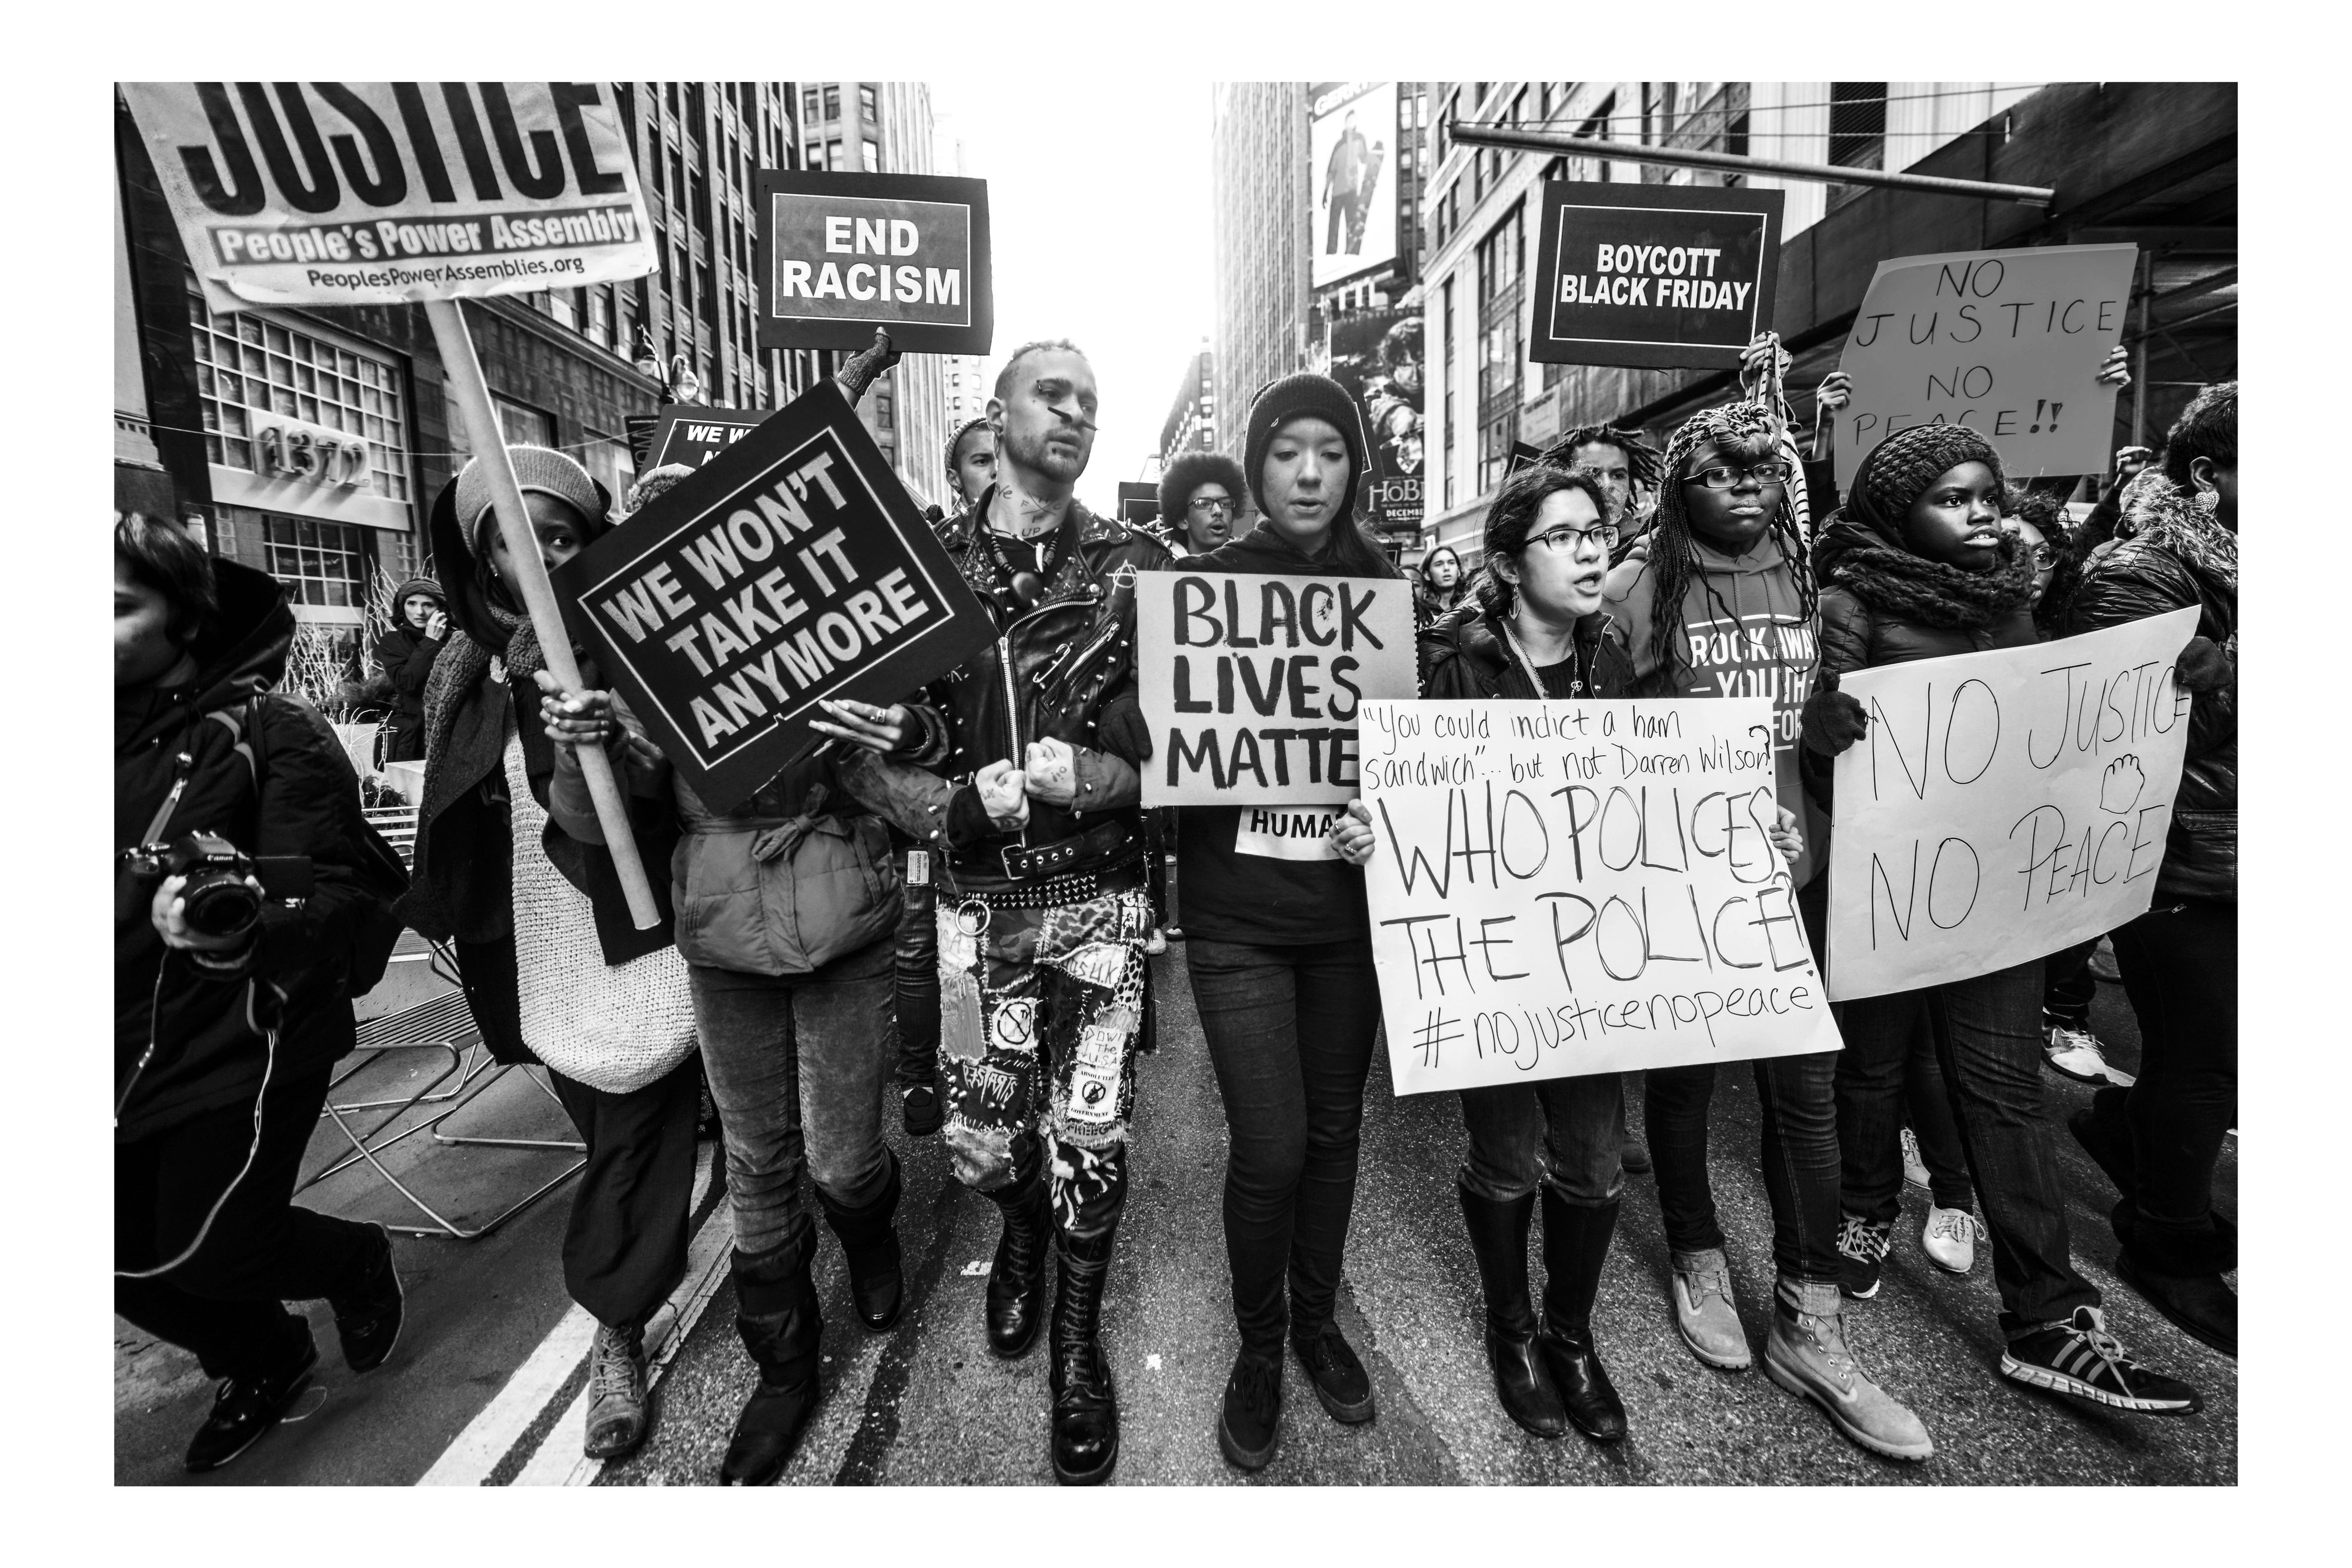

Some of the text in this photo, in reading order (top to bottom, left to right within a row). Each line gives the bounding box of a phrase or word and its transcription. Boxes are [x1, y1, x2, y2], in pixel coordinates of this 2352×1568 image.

[218, 208, 636, 262] People's Power Assembly
[826, 216, 918, 256] END
[1597, 243, 1721, 277] BOYCOTT
[308, 255, 584, 290] PeoplesPowerAssemblies.org
[782, 260, 960, 305] RACISM
[1561, 274, 1752, 310] BLACK FRIDAY
[1936, 259, 2004, 297] NO
[1856, 299, 2116, 347] JUSTICE
[1927, 366, 1993, 401] NO
[260, 425, 370, 487] 1372
[687, 424, 724, 443] WE
[1387, 508, 1425, 517] DECEMBE
[600, 451, 847, 643] WE WON'T
[665, 527, 858, 677] TAKE IT
[1173, 576, 1384, 651] BLACK
[689, 567, 929, 748] ANYMORE
[1689, 627, 1815, 668] ROCKAWA
[1174, 655, 1362, 722] LIVES
[1716, 666, 1808, 703] YOUTH
[1435, 708, 1490, 739] could
[1509, 705, 1590, 740] indict
[1603, 711, 1616, 737] a
[1632, 705, 1681, 738] ham
[1872, 678, 1999, 801] NO
[1167, 727, 1360, 790] MATTE
[1511, 753, 1544, 783] but
[1562, 746, 1606, 780] not
[1611, 743, 1689, 780] Darren
[1699, 724, 1773, 775] Wilson?
[1251, 809, 1339, 838] HUMA
[1377, 780, 1775, 900] WHO POLICES
[1872, 804, 2165, 951] NO PEACE
[1380, 871, 1815, 1000] THE POLICE?
[1413, 983, 1813, 1071] #nojusticenopeace
